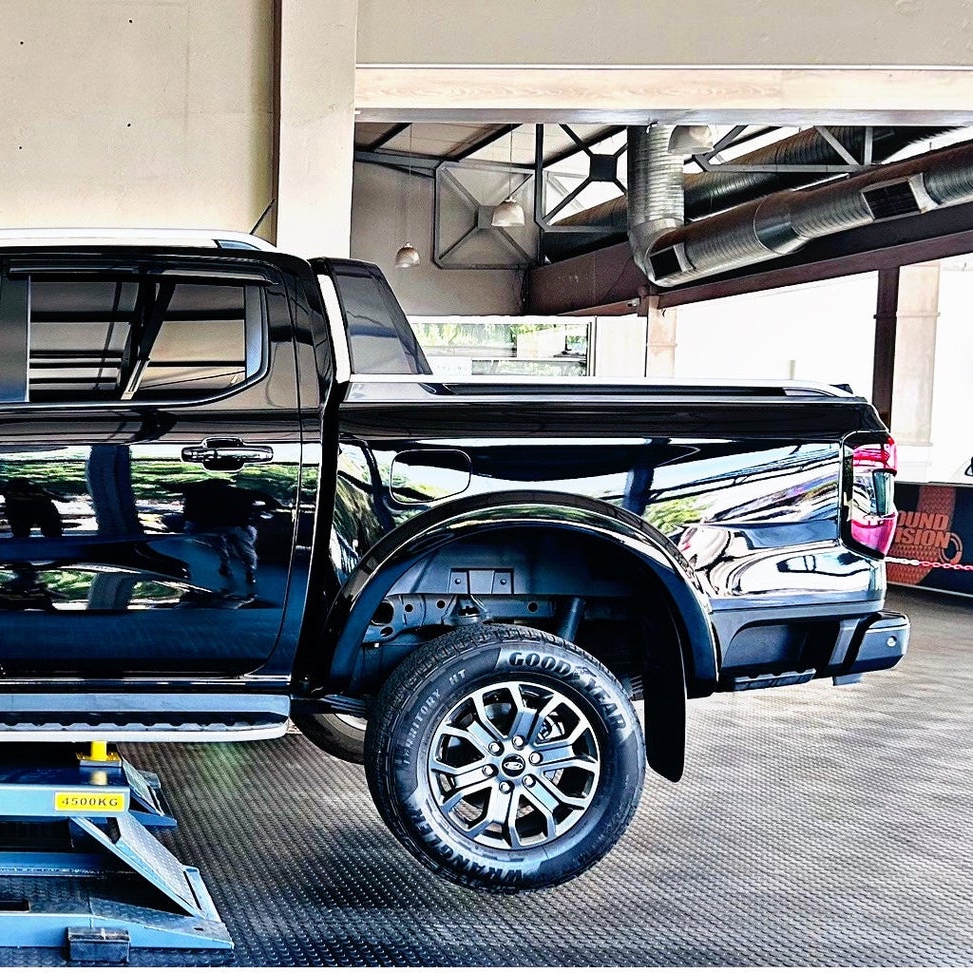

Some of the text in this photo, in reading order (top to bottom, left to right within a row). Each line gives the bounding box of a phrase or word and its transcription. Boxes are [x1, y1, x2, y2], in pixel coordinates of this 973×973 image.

[896, 510, 950, 531] OUND
[893, 526, 951, 549] ISION
[61, 797, 119, 807] 4500KG
